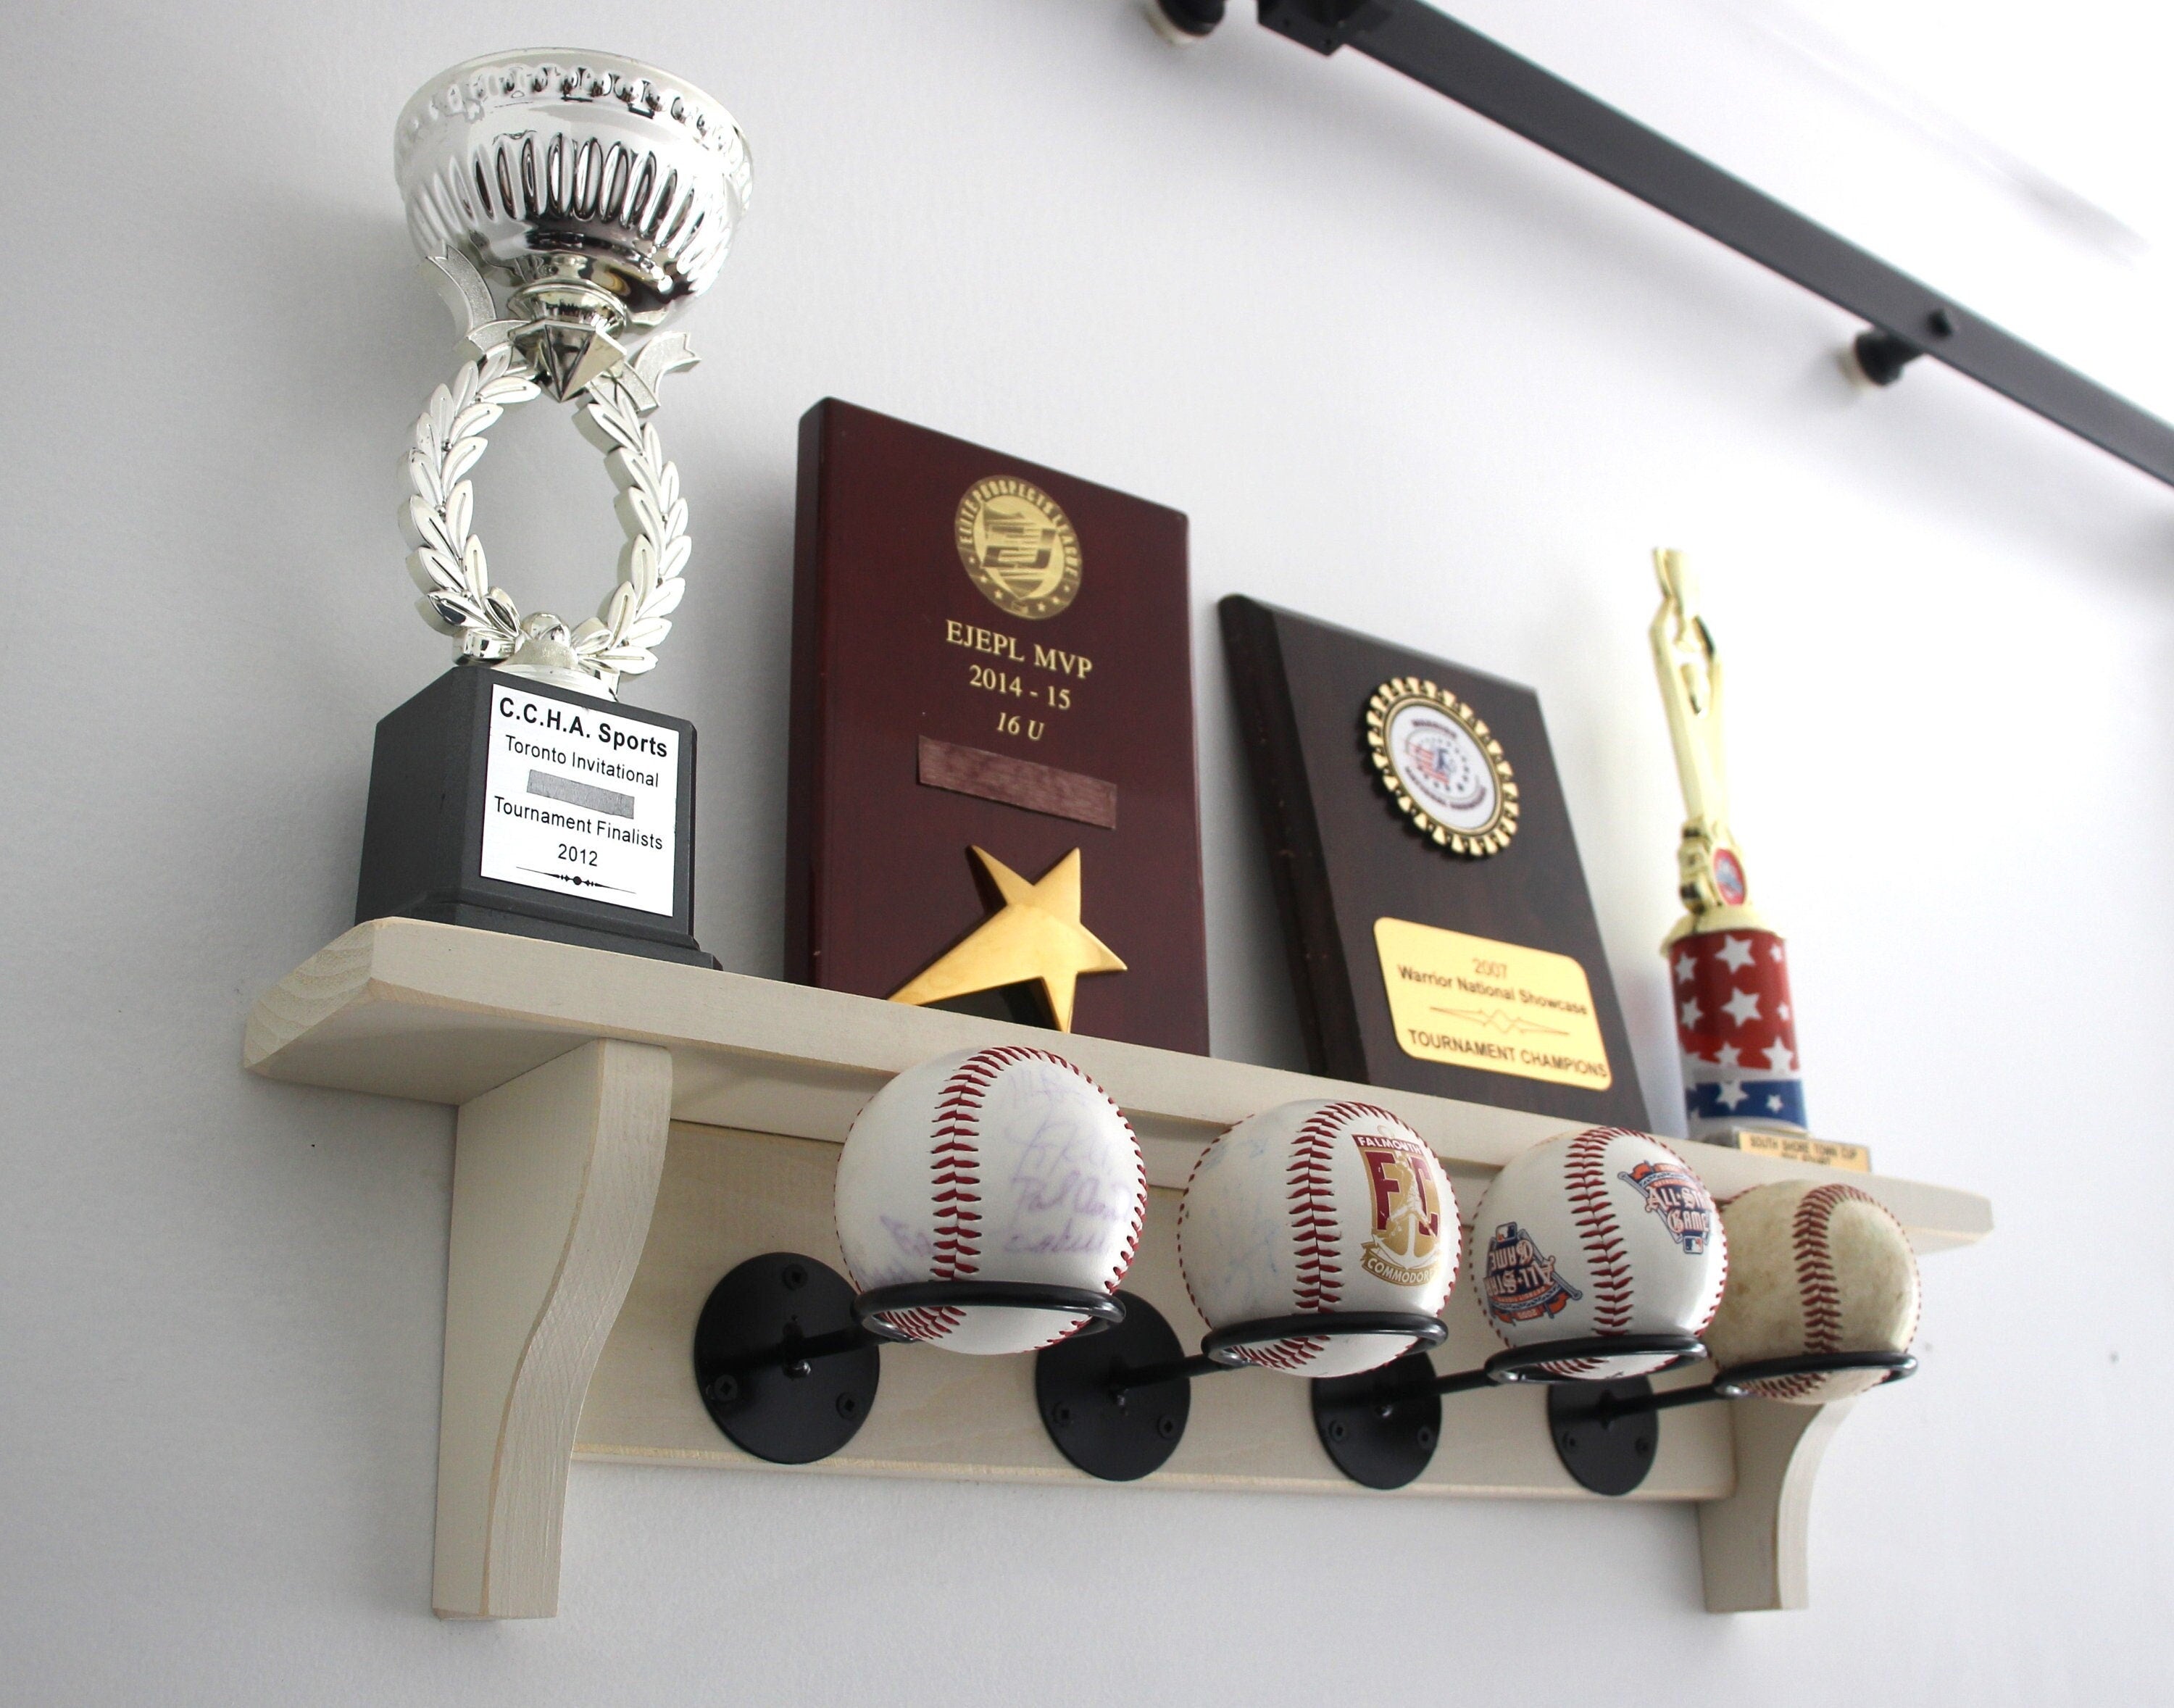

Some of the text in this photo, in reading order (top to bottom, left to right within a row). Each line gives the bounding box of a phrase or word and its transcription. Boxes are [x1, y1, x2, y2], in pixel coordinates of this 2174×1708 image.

[946, 619, 1093, 679] EJEPL MVP
[969, 665, 1023, 697] 2014
[1048, 686, 1071, 710] 15
[499, 697, 667, 757] C.C.H.A. Sports
[996, 712, 1045, 741] 16 U
[505, 734, 659, 788] Toronto Invitational
[494, 795, 663, 850] Tournament Finalists
[558, 843, 598, 867] 2012
[1397, 965, 1588, 1015] Warrior National Showcase
[1472, 957, 1508, 978] 2007
[1408, 1029, 1608, 1078] TOURNAMENT CHAMPIONS
[1357, 1136, 1423, 1154] FALMOUTH
[1489, 1240, 1533, 1271] GAME
